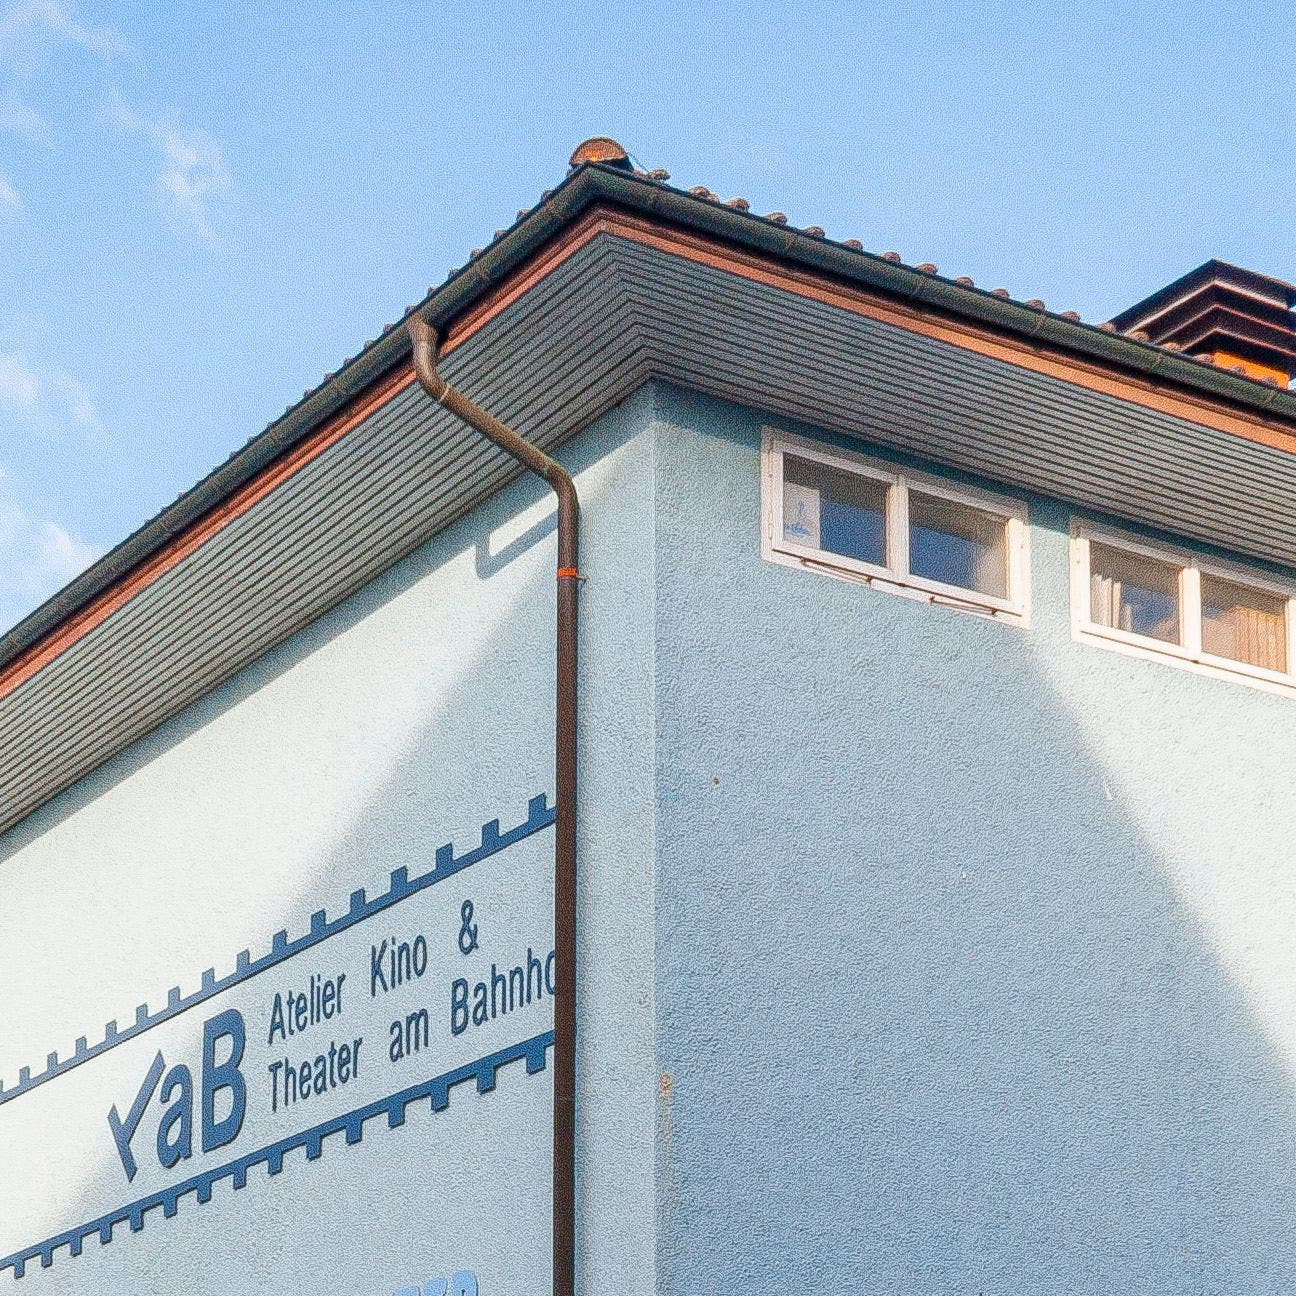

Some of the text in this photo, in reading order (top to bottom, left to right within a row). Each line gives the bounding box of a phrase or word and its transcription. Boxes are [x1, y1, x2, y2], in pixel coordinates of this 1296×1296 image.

[268, 900, 480, 1045] Atelier Kino &
[268, 948, 555, 1112] Theater am Bahnho
